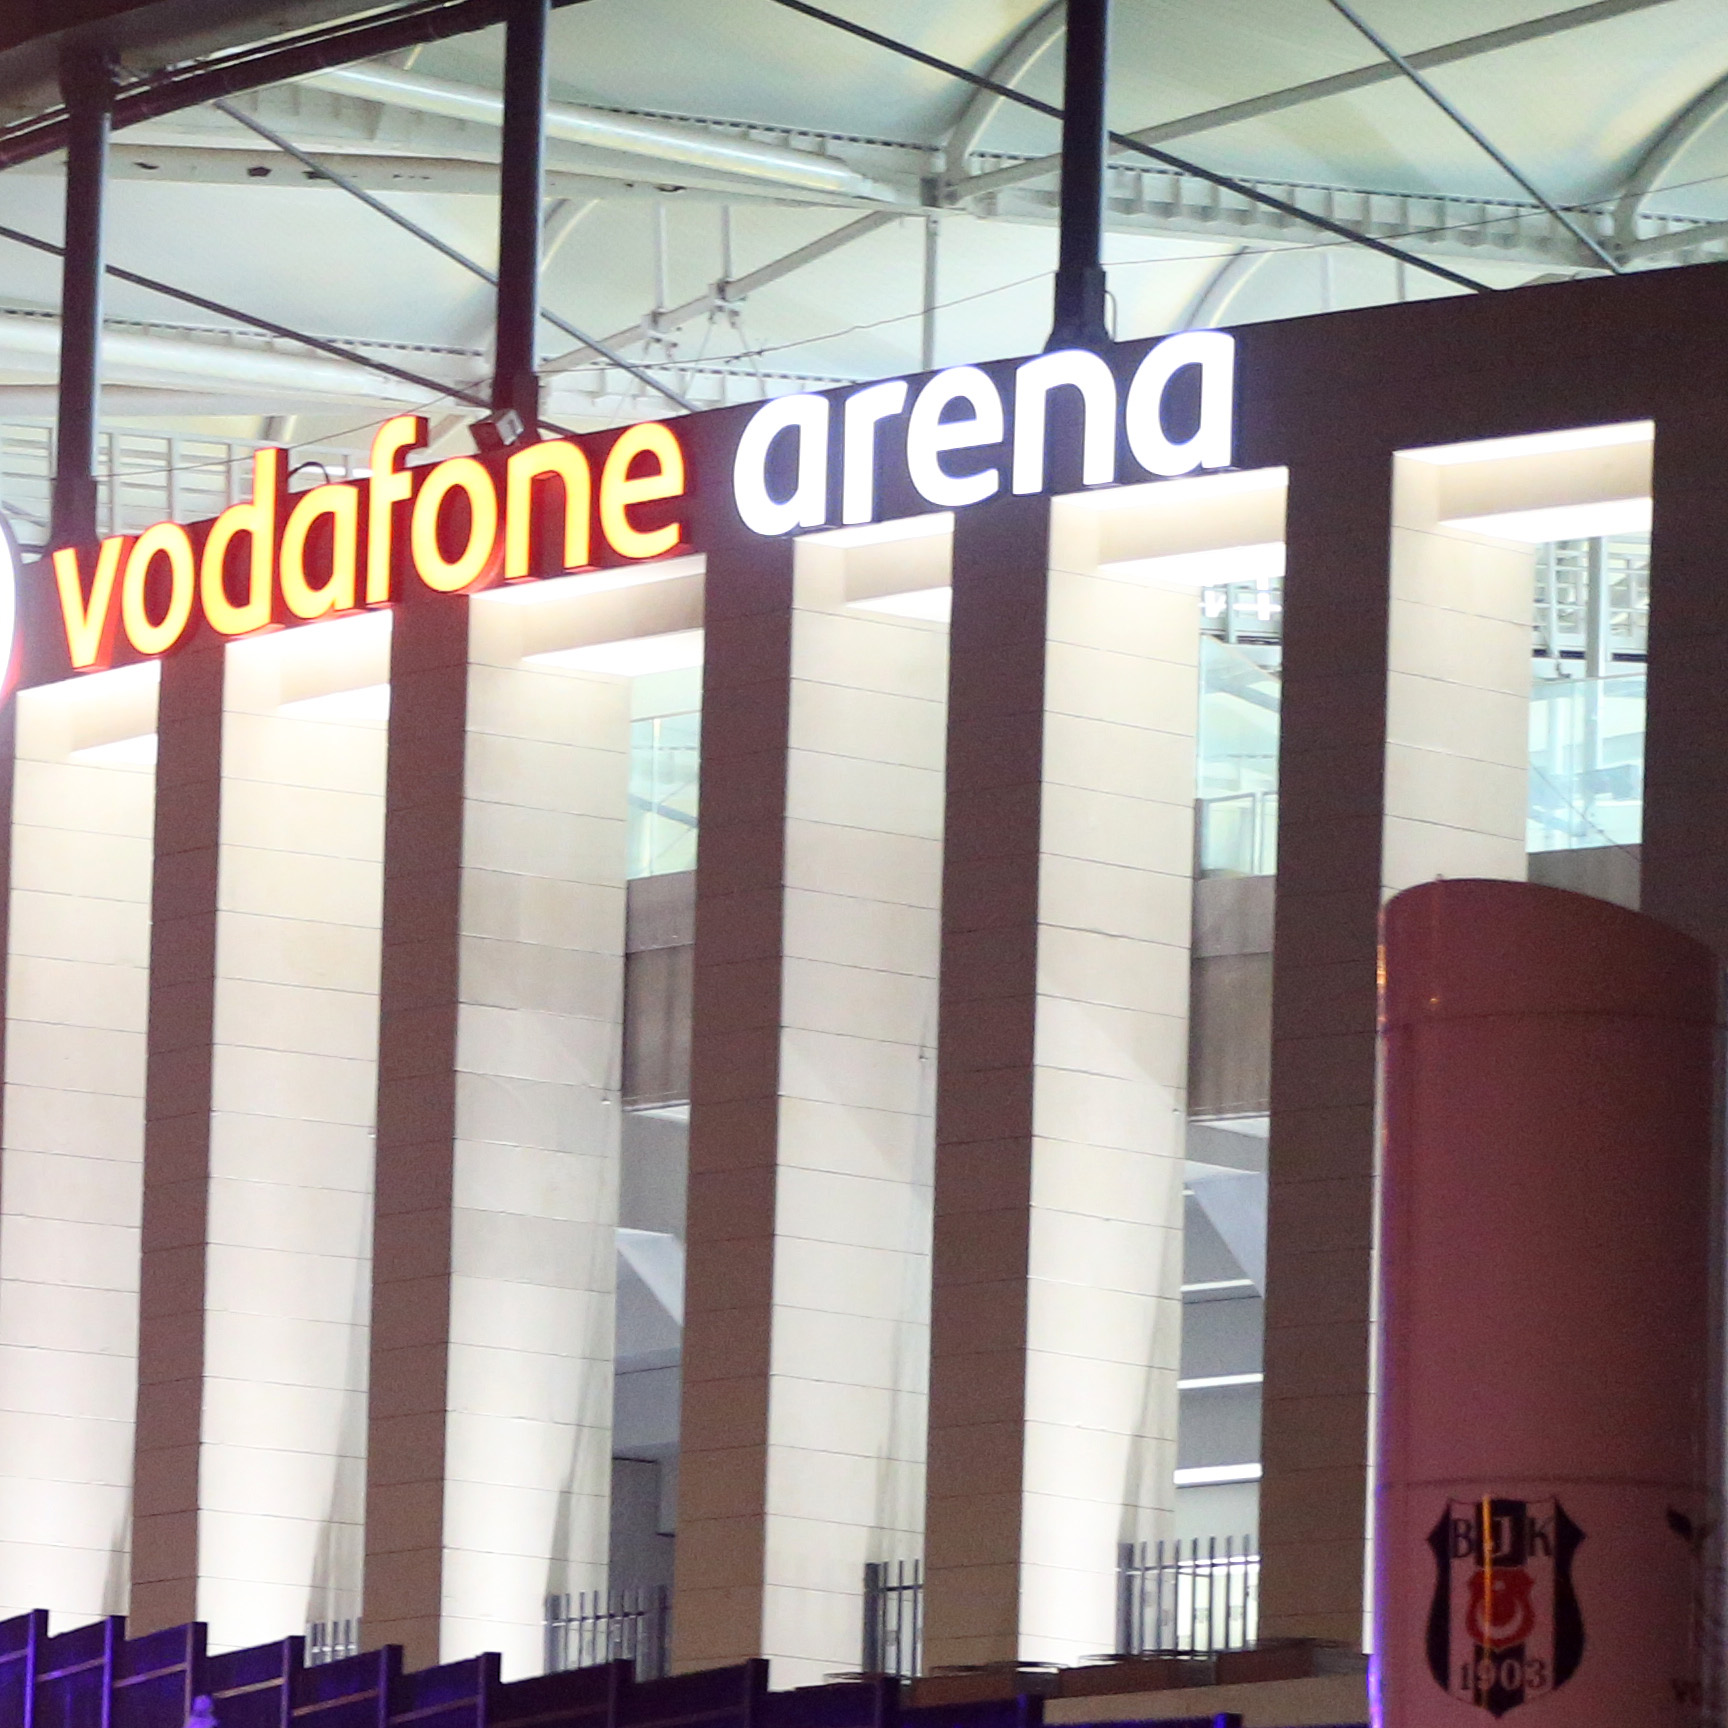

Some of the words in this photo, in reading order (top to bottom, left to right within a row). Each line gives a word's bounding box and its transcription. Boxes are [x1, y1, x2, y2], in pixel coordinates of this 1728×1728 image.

[52, 416, 686, 671] vodafone
[734, 331, 1237, 538] arena
[1451, 1513, 1553, 1560] BJK
[1458, 1660, 1548, 1693] 1903
